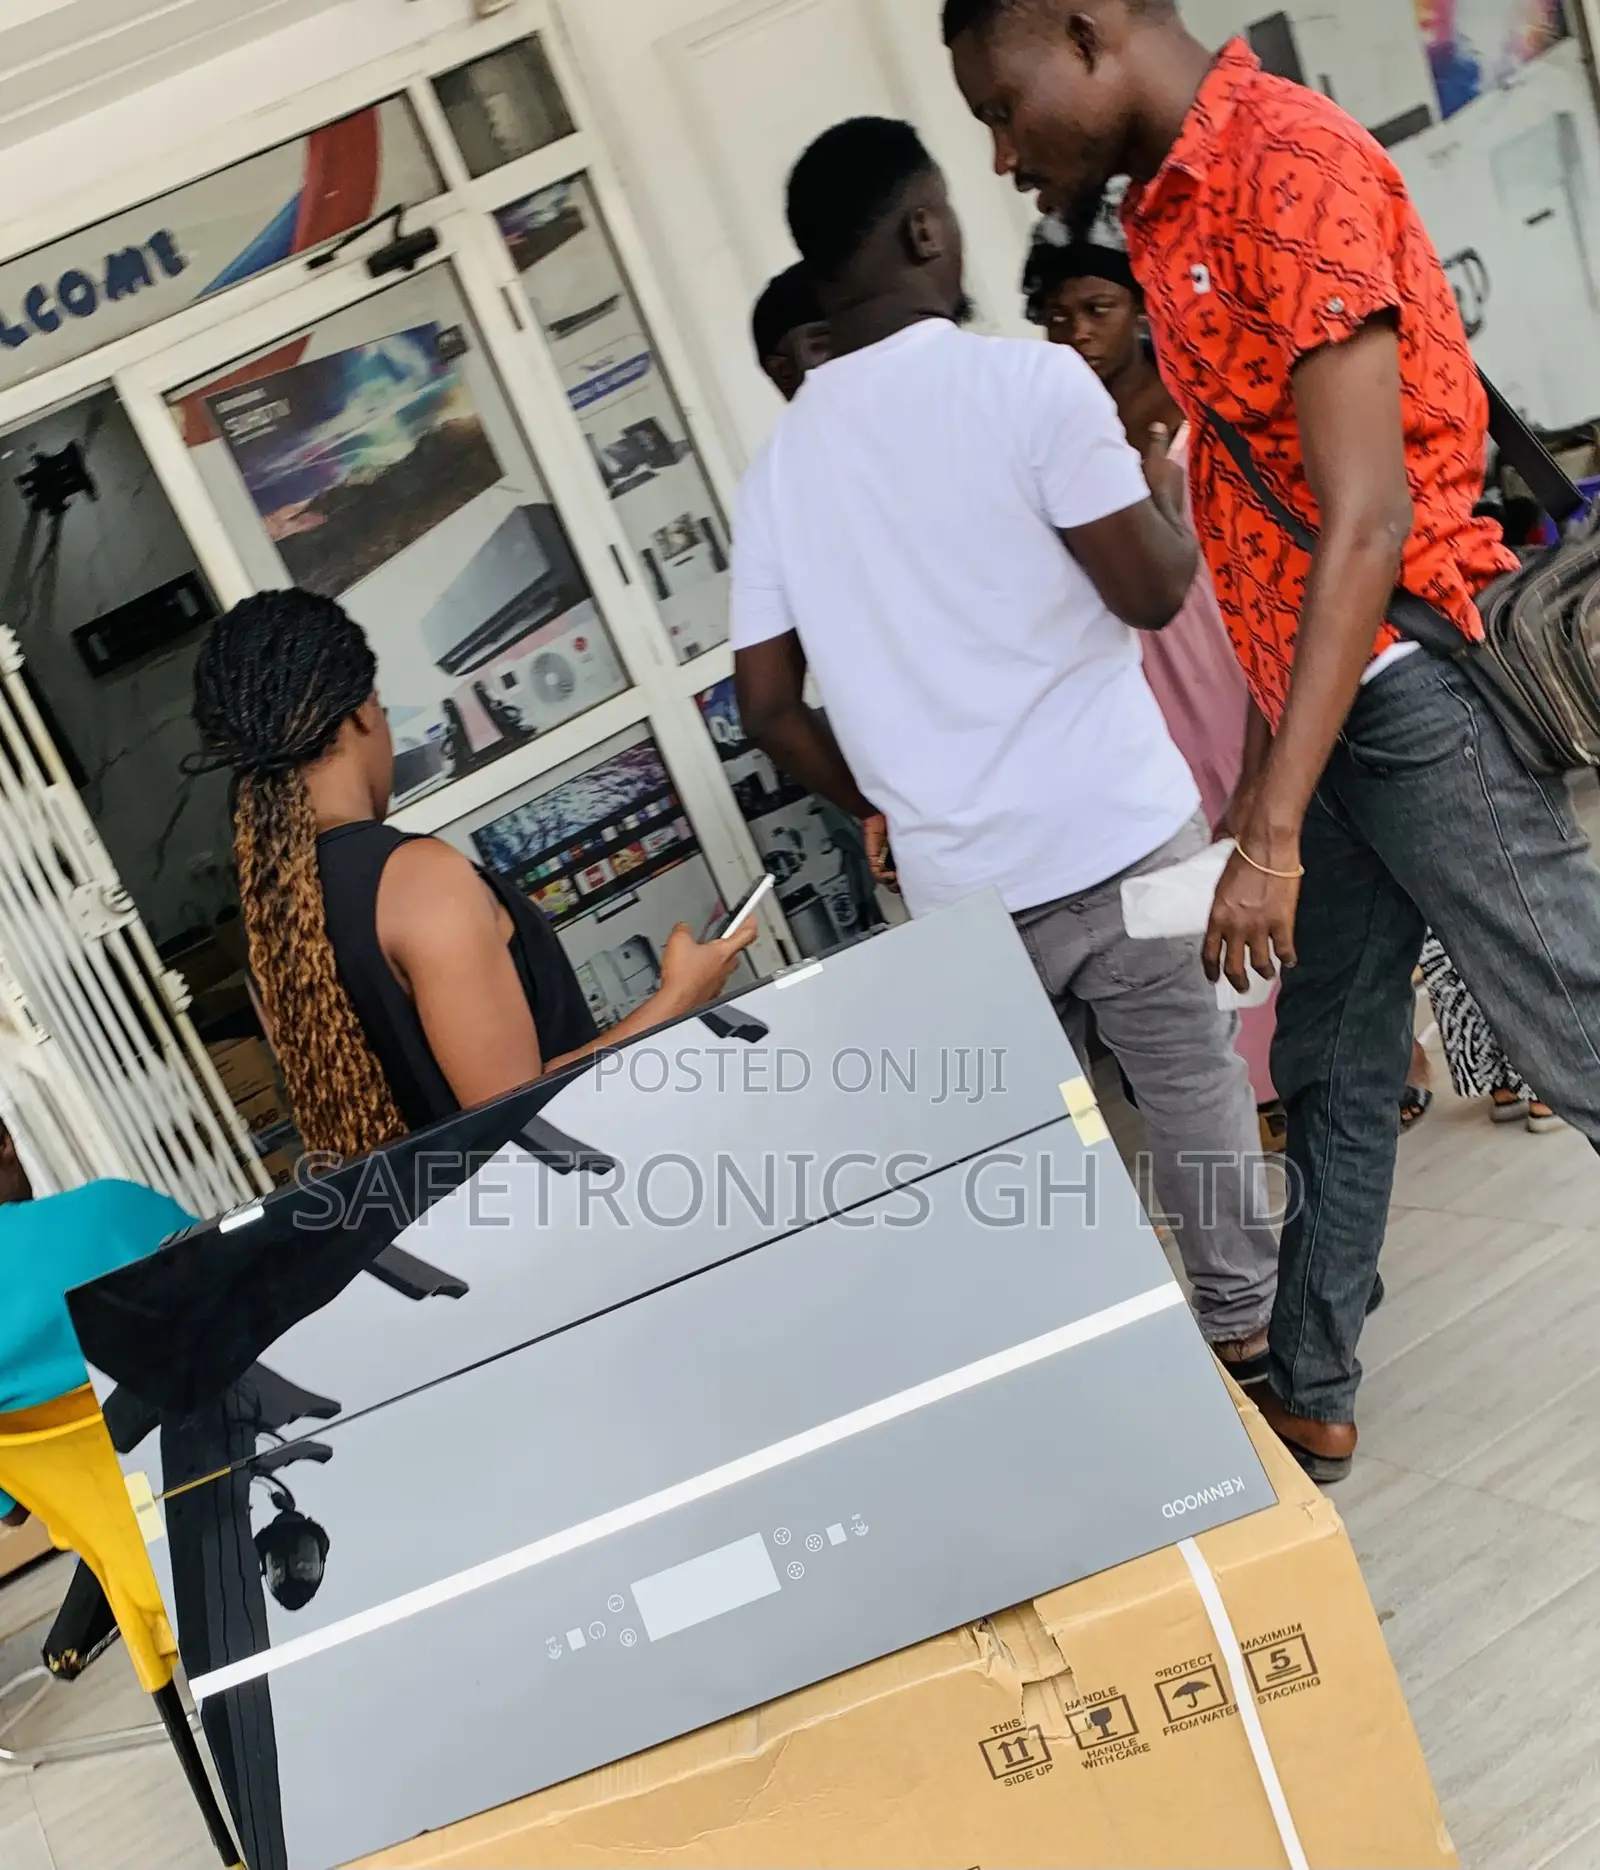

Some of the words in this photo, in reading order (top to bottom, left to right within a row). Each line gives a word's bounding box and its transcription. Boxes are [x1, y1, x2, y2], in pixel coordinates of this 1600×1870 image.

[1161, 1475, 1246, 1519] KENWOOD
[1240, 1622, 1303, 1651] MAXIMUM
[1269, 1648, 1292, 1671] 5
[1257, 1676, 1321, 1706] STACKING
[990, 1717, 1022, 1736] THIS
[1162, 1717, 1201, 1737] FROM
[1081, 1755, 1116, 1771] WITH
[1115, 1742, 1152, 1762] CARE
[1086, 1736, 1138, 1760] HANDLE
[1003, 1769, 1036, 1788] SIDE
[1035, 1763, 1054, 1778] UP
